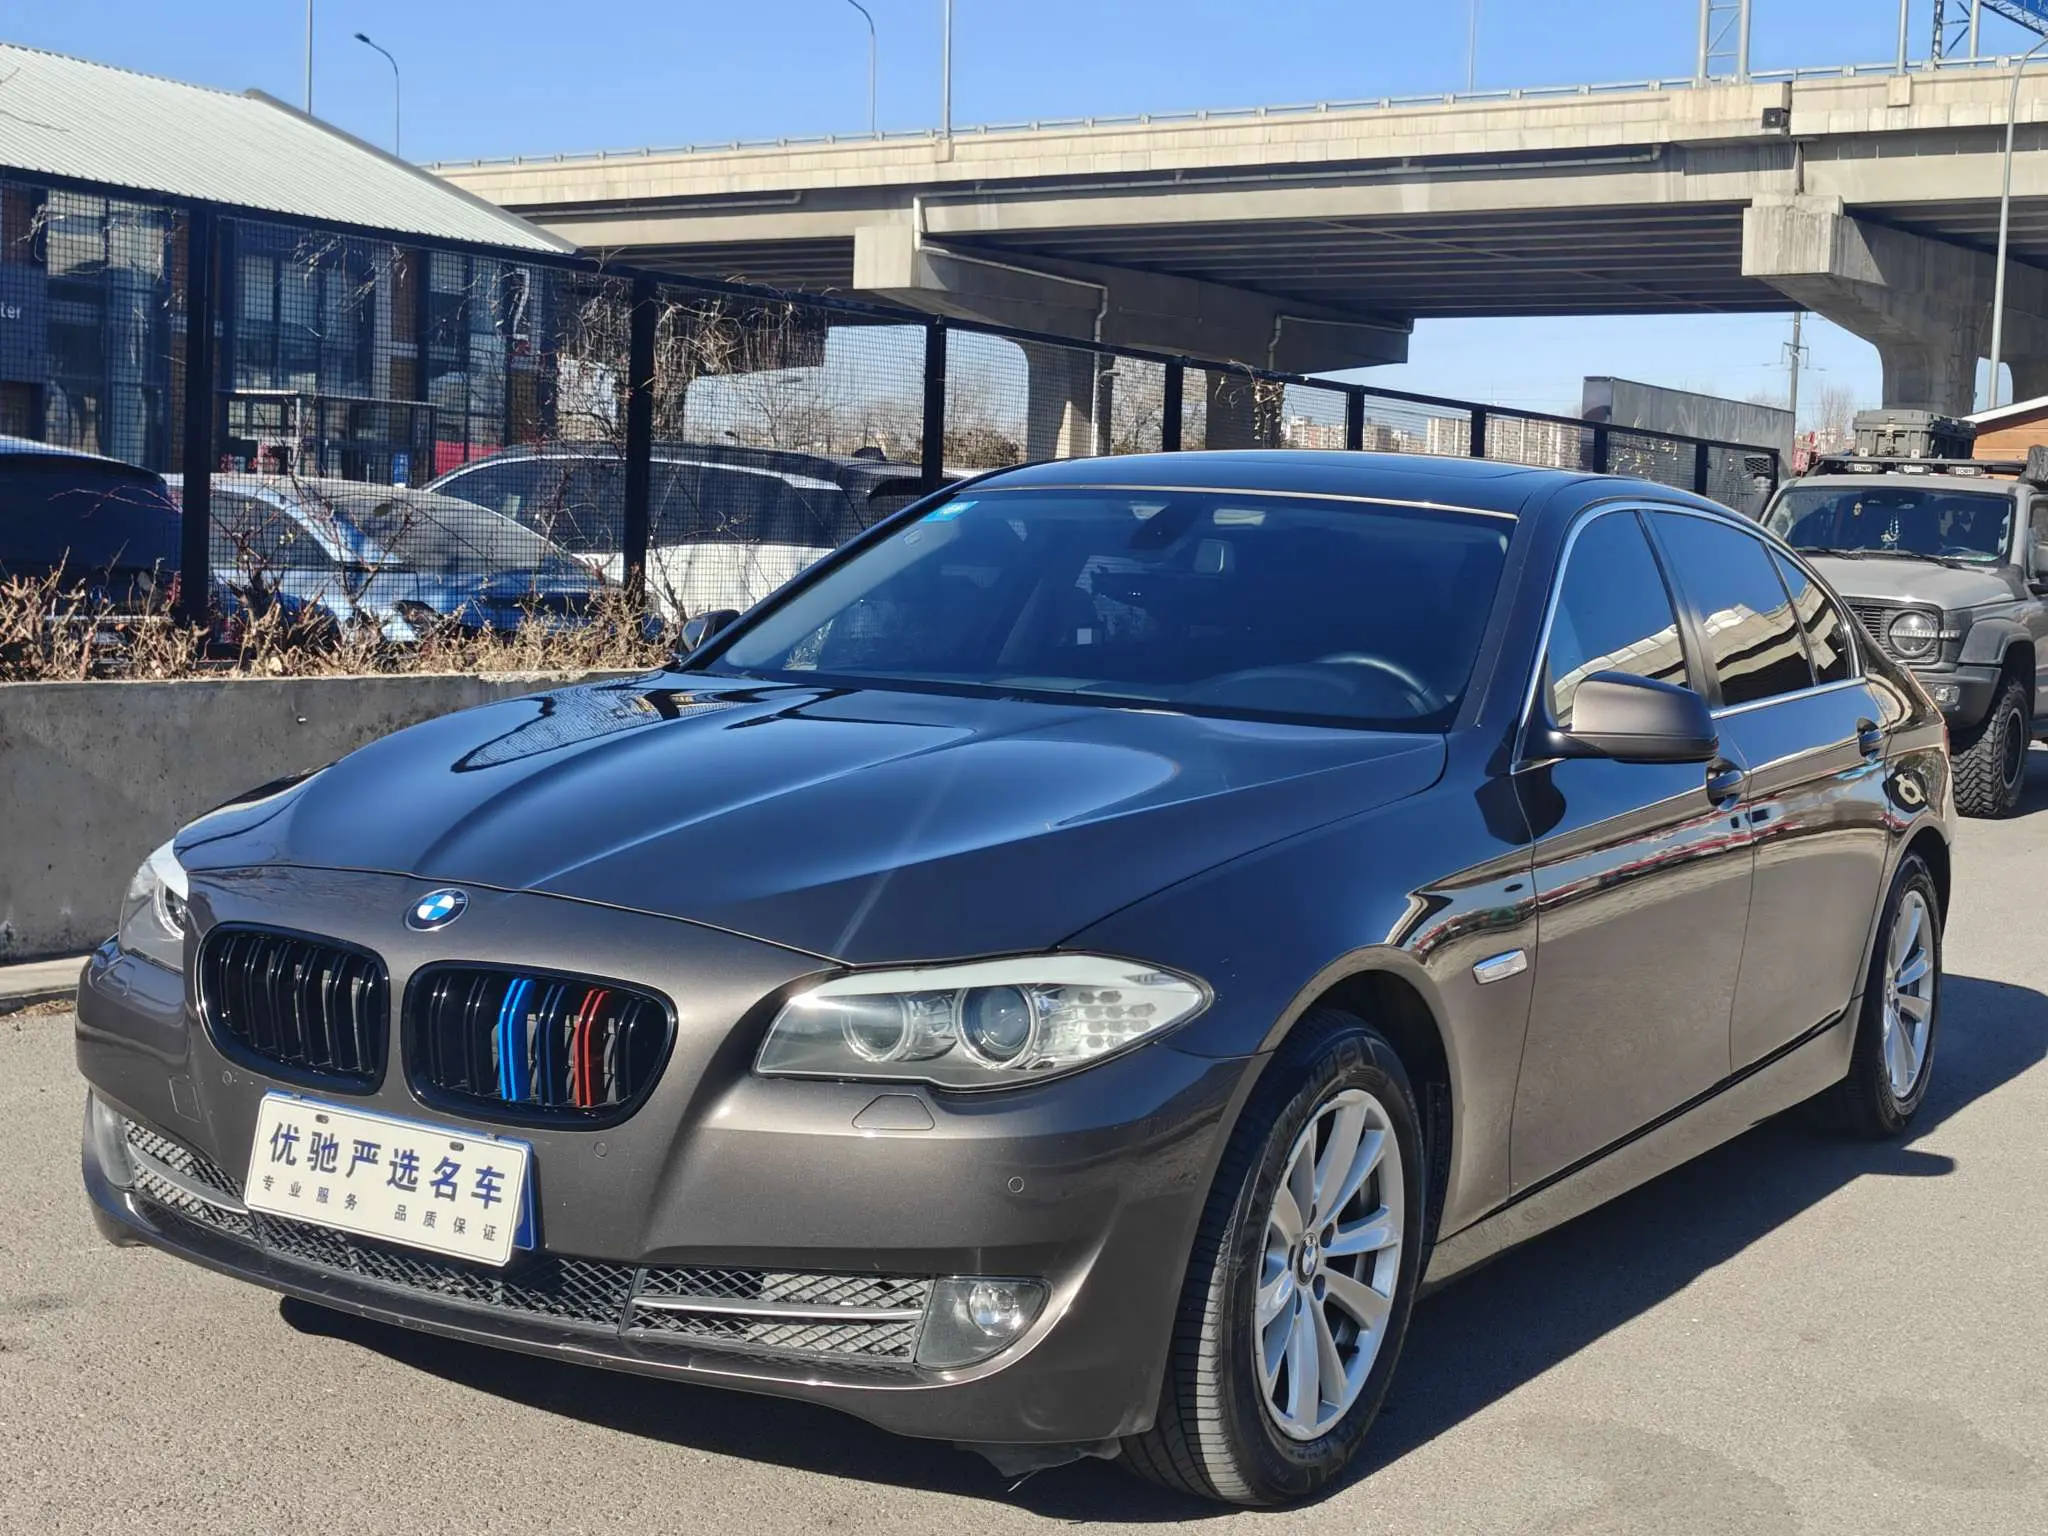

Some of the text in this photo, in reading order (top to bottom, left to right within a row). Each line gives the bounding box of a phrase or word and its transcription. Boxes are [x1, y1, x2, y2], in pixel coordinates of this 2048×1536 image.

[269, 1121, 505, 1209] 优驰严选名车
[263, 1174, 497, 1243] 专业服务 品质保证
